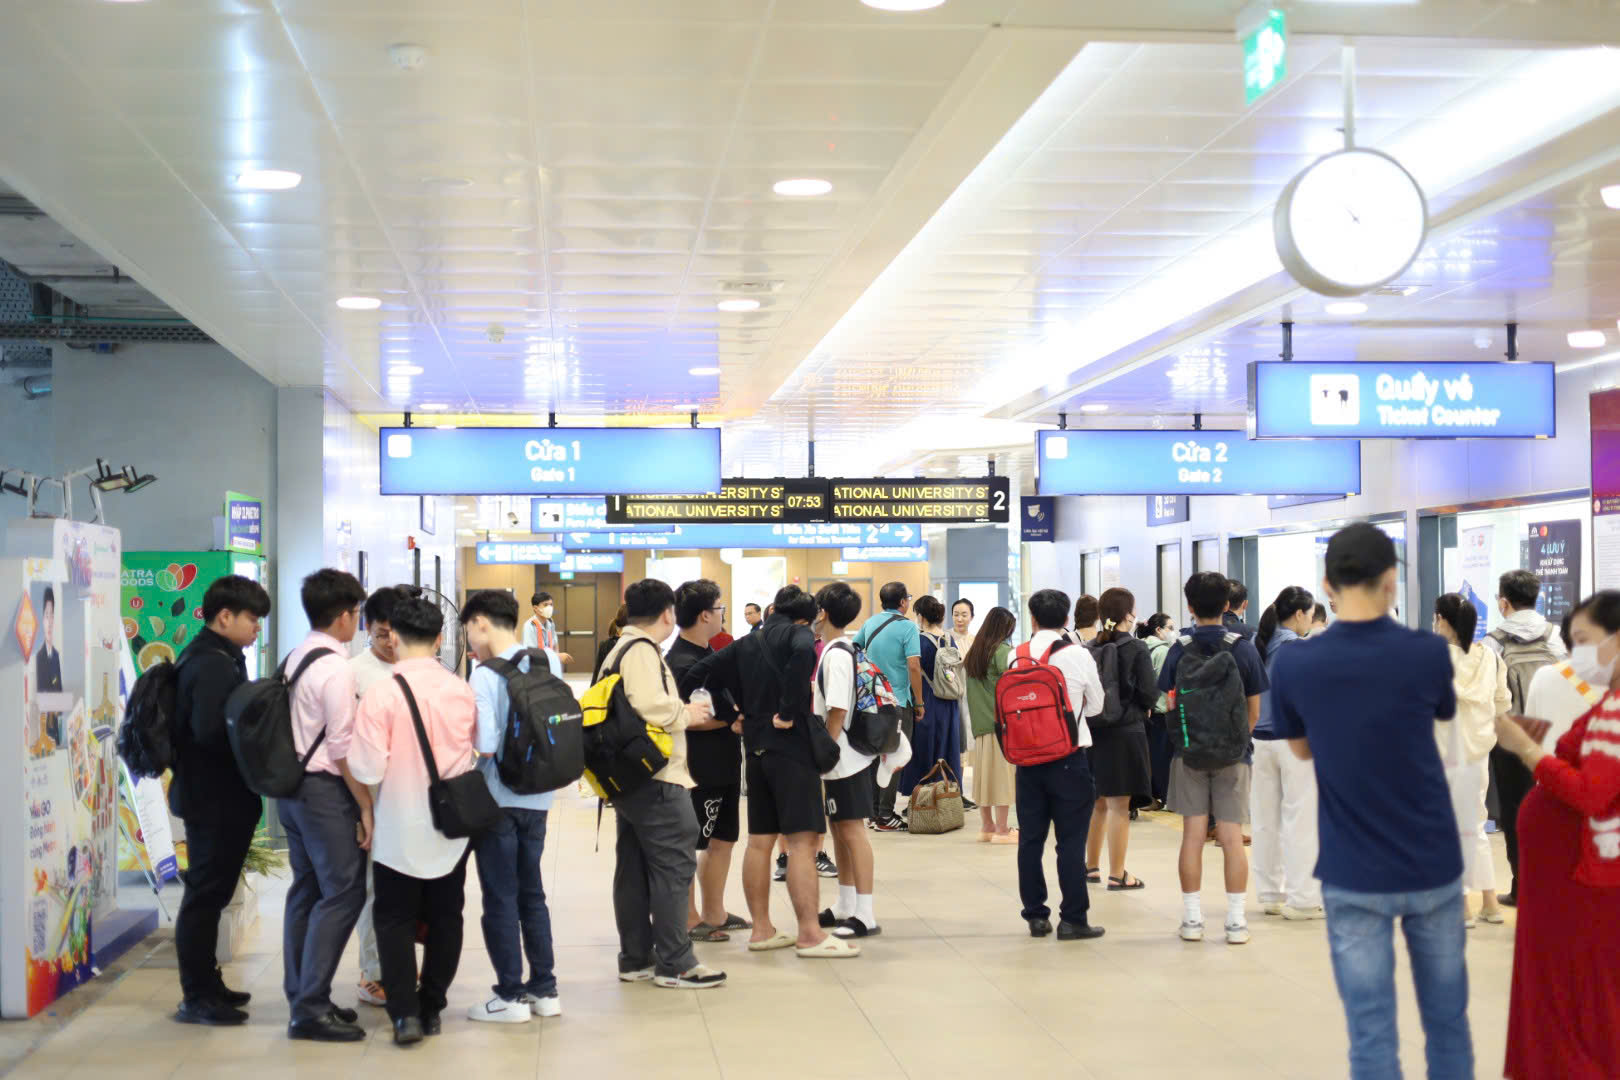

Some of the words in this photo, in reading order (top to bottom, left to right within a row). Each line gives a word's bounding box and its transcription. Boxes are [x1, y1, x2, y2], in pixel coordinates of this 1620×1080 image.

[1376, 405, 1429, 426] Ticket
[1431, 405, 1501, 427] Counter
[525, 438, 567, 461] Cửa
[571, 440, 581, 461] 1
[1172, 440, 1212, 463] Cửa
[1215, 442, 1229, 462] 2
[530, 466, 566, 483] Gate
[567, 466, 576, 482] 1
[1177, 467, 1211, 483] Gate
[1211, 467, 1223, 483] 2
[892, 487, 974, 499] UNIVERSITY
[993, 490, 1006, 511] 2
[787, 496, 821, 508] 07:53
[685, 505, 769, 517] UNIVERSITY
[892, 505, 974, 517] UNIVERSITY
